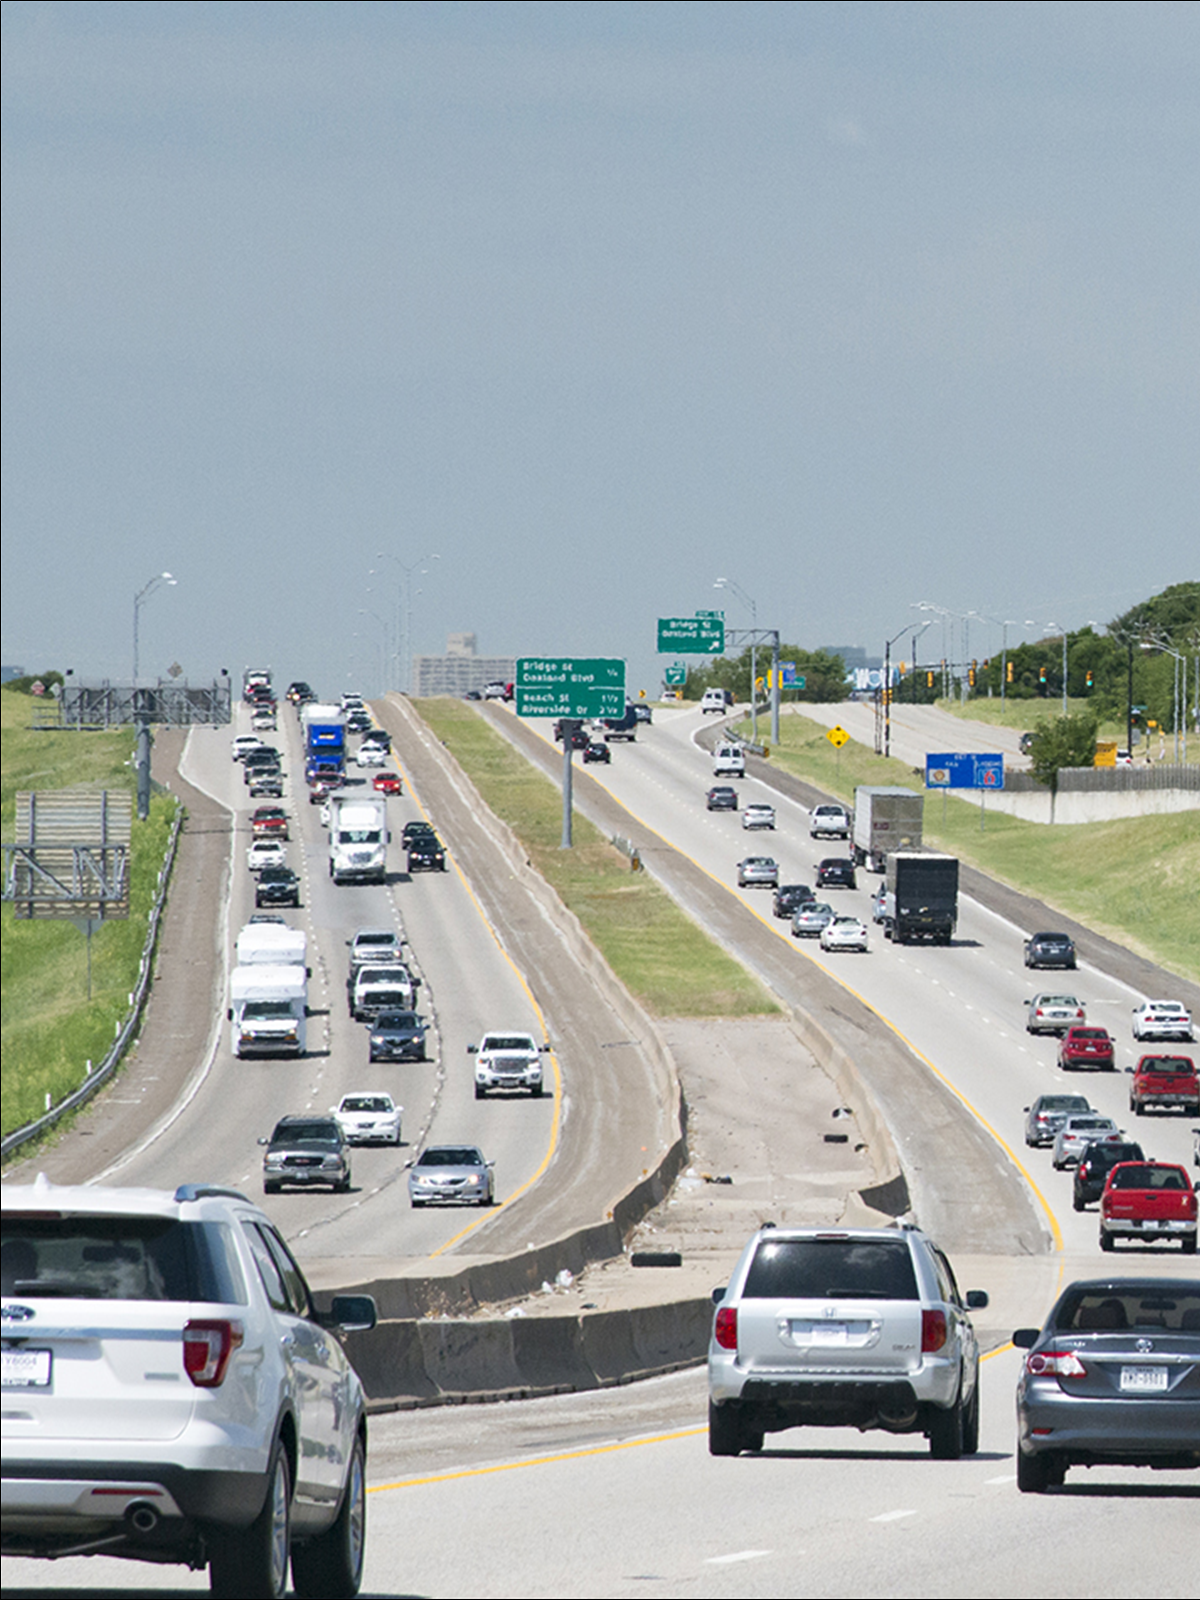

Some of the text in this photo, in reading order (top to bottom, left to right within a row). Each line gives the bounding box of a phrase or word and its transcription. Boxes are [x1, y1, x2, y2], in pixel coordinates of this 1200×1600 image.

[522, 662, 558, 672] Bridge
[523, 673, 566, 682] Oakland
[523, 694, 555, 702] Beach
[521, 705, 571, 714] Riverside
